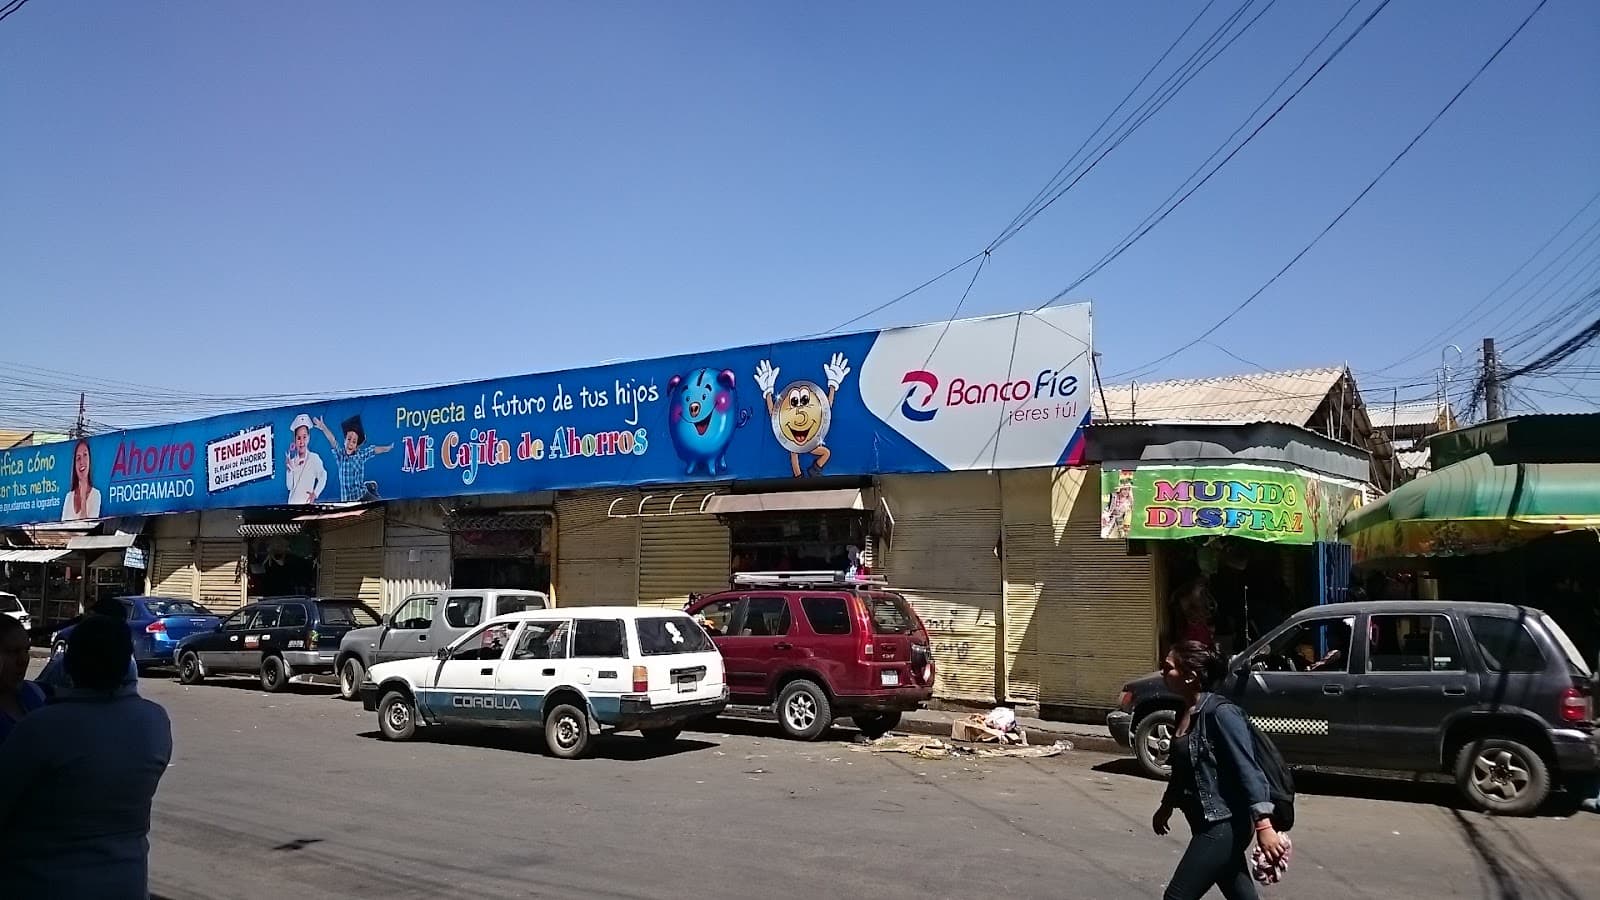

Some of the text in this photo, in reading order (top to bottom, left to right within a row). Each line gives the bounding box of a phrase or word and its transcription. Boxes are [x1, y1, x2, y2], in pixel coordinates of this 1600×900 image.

[396, 378, 660, 431] Proyecta el futuro de tus hijos
[1009, 401, 1077, 426] ¡eres tú!
[110, 441, 196, 478] Ahorro
[214, 434, 266, 462] TENEMOS
[220, 463, 231, 471] PLAN
[240, 451, 266, 465] AHORRO
[401, 426, 649, 485] Mi Cajita de Ahorros
[28, 450, 56, 473] cómo
[214, 462, 267, 485] QUE NECESITAS
[12, 480, 28, 496] tus
[109, 478, 195, 505] PROGRAMADO
[1154, 480, 1297, 507] MUNDO
[4, 501, 30, 513] ayudamos
[1144, 506, 1304, 533] DISFRAZ
[452, 695, 522, 710] COROLLA
